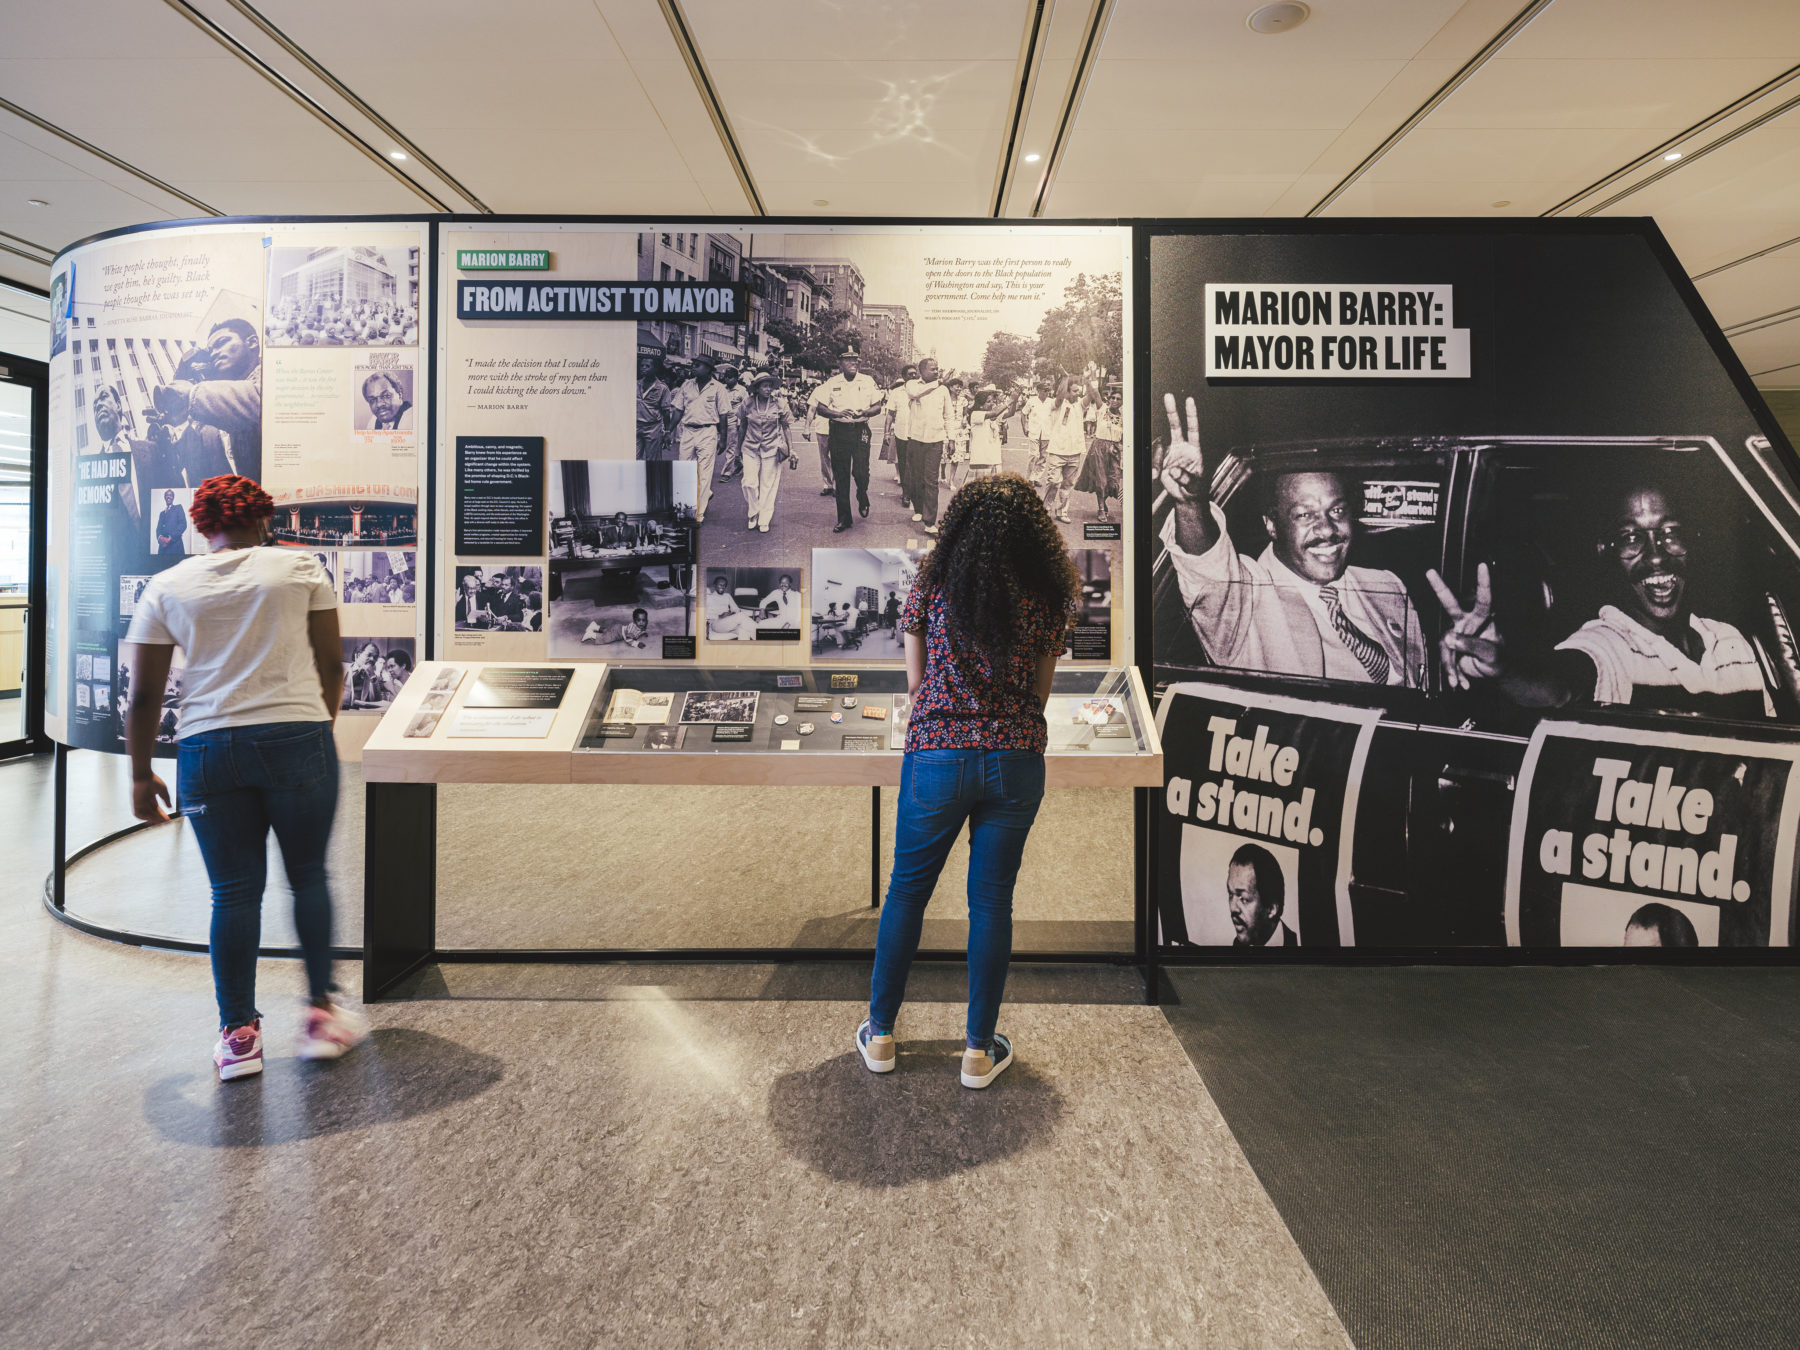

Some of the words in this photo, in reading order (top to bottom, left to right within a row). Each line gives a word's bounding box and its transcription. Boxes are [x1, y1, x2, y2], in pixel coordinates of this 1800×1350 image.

[123, 260, 145, 276] people
[146, 256, 179, 271] thought,
[179, 253, 210, 270] finally
[461, 253, 507, 267] MARION
[508, 253, 545, 267] BARRY
[924, 258, 953, 267] “Marion
[955, 258, 976, 268] Barry
[993, 258, 1004, 267] the
[1003, 258, 1020, 269] first
[1020, 260, 1043, 268] person
[1045, 259, 1052, 267] to
[1052, 258, 1072, 269] really
[185, 270, 211, 282] Black
[925, 271, 941, 279] open
[1014, 270, 1052, 280] population
[925, 281, 935, 291] of
[934, 281, 974, 290] Washington
[975, 281, 989, 289] and
[1005, 281, 1021, 289] This
[1022, 281, 1028, 289] is
[102, 296, 123, 312] people
[123, 291, 151, 306] thought
[151, 290, 161, 301] he
[163, 292, 180, 300] was
[463, 286, 524, 312] FROM
[527, 286, 626, 313] ACTIVIST
[629, 287, 662, 313] TO
[663, 288, 735, 314] MAYOR
[925, 293, 968, 302] government.
[970, 292, 990, 300] Come
[992, 292, 1006, 302] help
[1033, 292, 1045, 300] it.”
[1215, 291, 1332, 326] MARION
[1339, 291, 1444, 326] BARRY:
[1215, 335, 1315, 370] MAYOR
[1322, 336, 1378, 370] FOR
[1385, 336, 1447, 370] LIFE
[465, 358, 474, 368] “I
[475, 358, 496, 368] made
[498, 358, 510, 368] the
[512, 358, 542, 368] decision
[544, 358, 561, 368] that
[562, 358, 567, 368] I
[568, 358, 590, 368] could
[490, 372, 509, 381] with
[511, 372, 523, 381] the
[524, 372, 547, 381] stroke
[549, 372, 559, 384] of
[559, 375, 570, 384] my
[572, 375, 587, 384] pen
[589, 372, 608, 381] than
[468, 386, 473, 395] I
[473, 386, 494, 395] could
[496, 386, 524, 397] kicking
[526, 386, 538, 395] the
[540, 386, 560, 395] doors
[562, 386, 592, 395] down.”
[91, 459, 109, 479] HAD
[109, 458, 127, 478] HIS
[1407, 489, 1434, 502] stand
[1207, 715, 1300, 787] Take
[1592, 757, 1714, 835] Take
[1166, 776, 1192, 817] a
[1196, 778, 1324, 847] stand.
[1539, 828, 1573, 876] a
[1582, 828, 1751, 903] stand.
